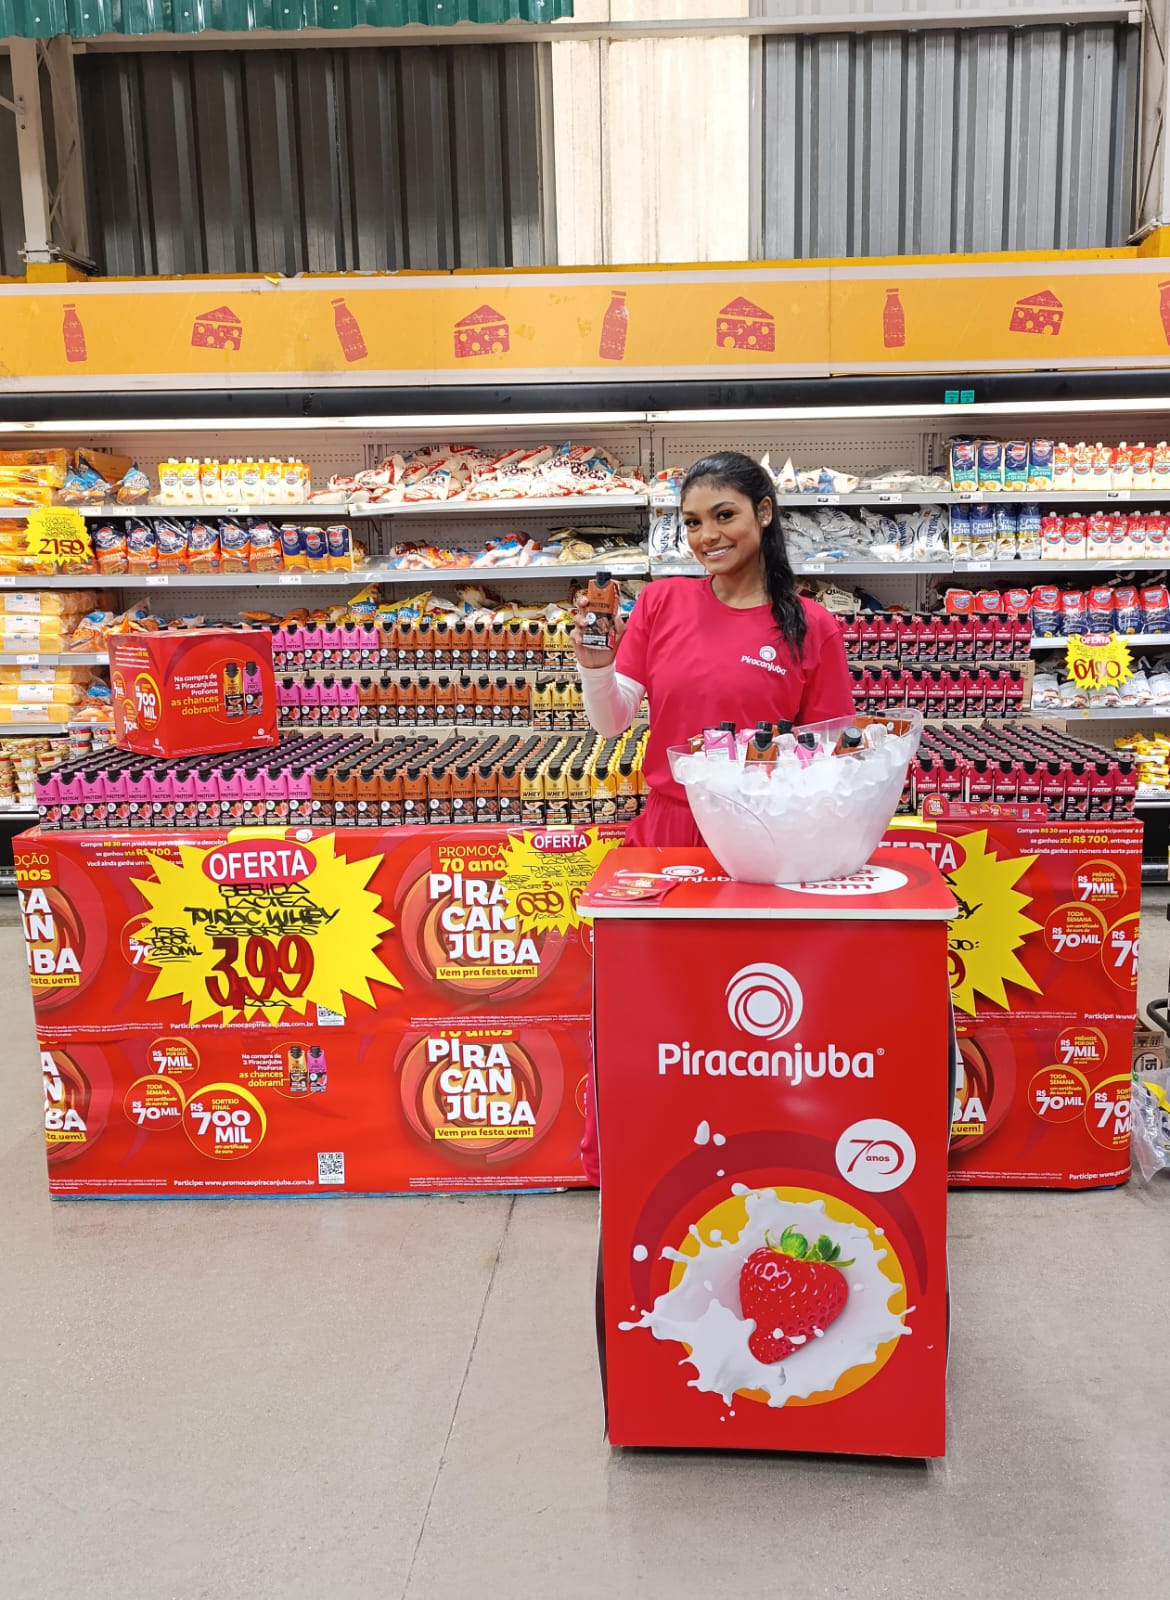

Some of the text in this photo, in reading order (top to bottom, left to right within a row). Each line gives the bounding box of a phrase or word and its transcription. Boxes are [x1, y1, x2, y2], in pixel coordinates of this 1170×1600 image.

[740, 655, 786, 676] Piracanjuba
[136, 692, 156, 712] 700
[183, 696, 218, 706] chances
[534, 835, 588, 849] OFERTA
[1073, 835, 1086, 844] R$
[209, 850, 309, 880] OFERTA
[440, 858, 464, 872] 70
[800, 882, 872, 890] bem
[1052, 934, 1100, 952] 70 MIL
[1112, 931, 1125, 940] R$
[450, 933, 540, 964] JUBA
[463, 970, 479, 978] pra
[428, 1038, 510, 1068] PIRA
[657, 1041, 874, 1086] Piracanjuba
[440, 1069, 512, 1094] CAN
[1095, 1092, 1108, 1101] R$
[190, 1103, 203, 1112] R$
[446, 1095, 536, 1125] JUBA
[1036, 1097, 1084, 1115] 70 MIL
[191, 1110, 251, 1135] 700
[215, 1126, 252, 1143] MIL
[847, 1139, 904, 1174] 70
